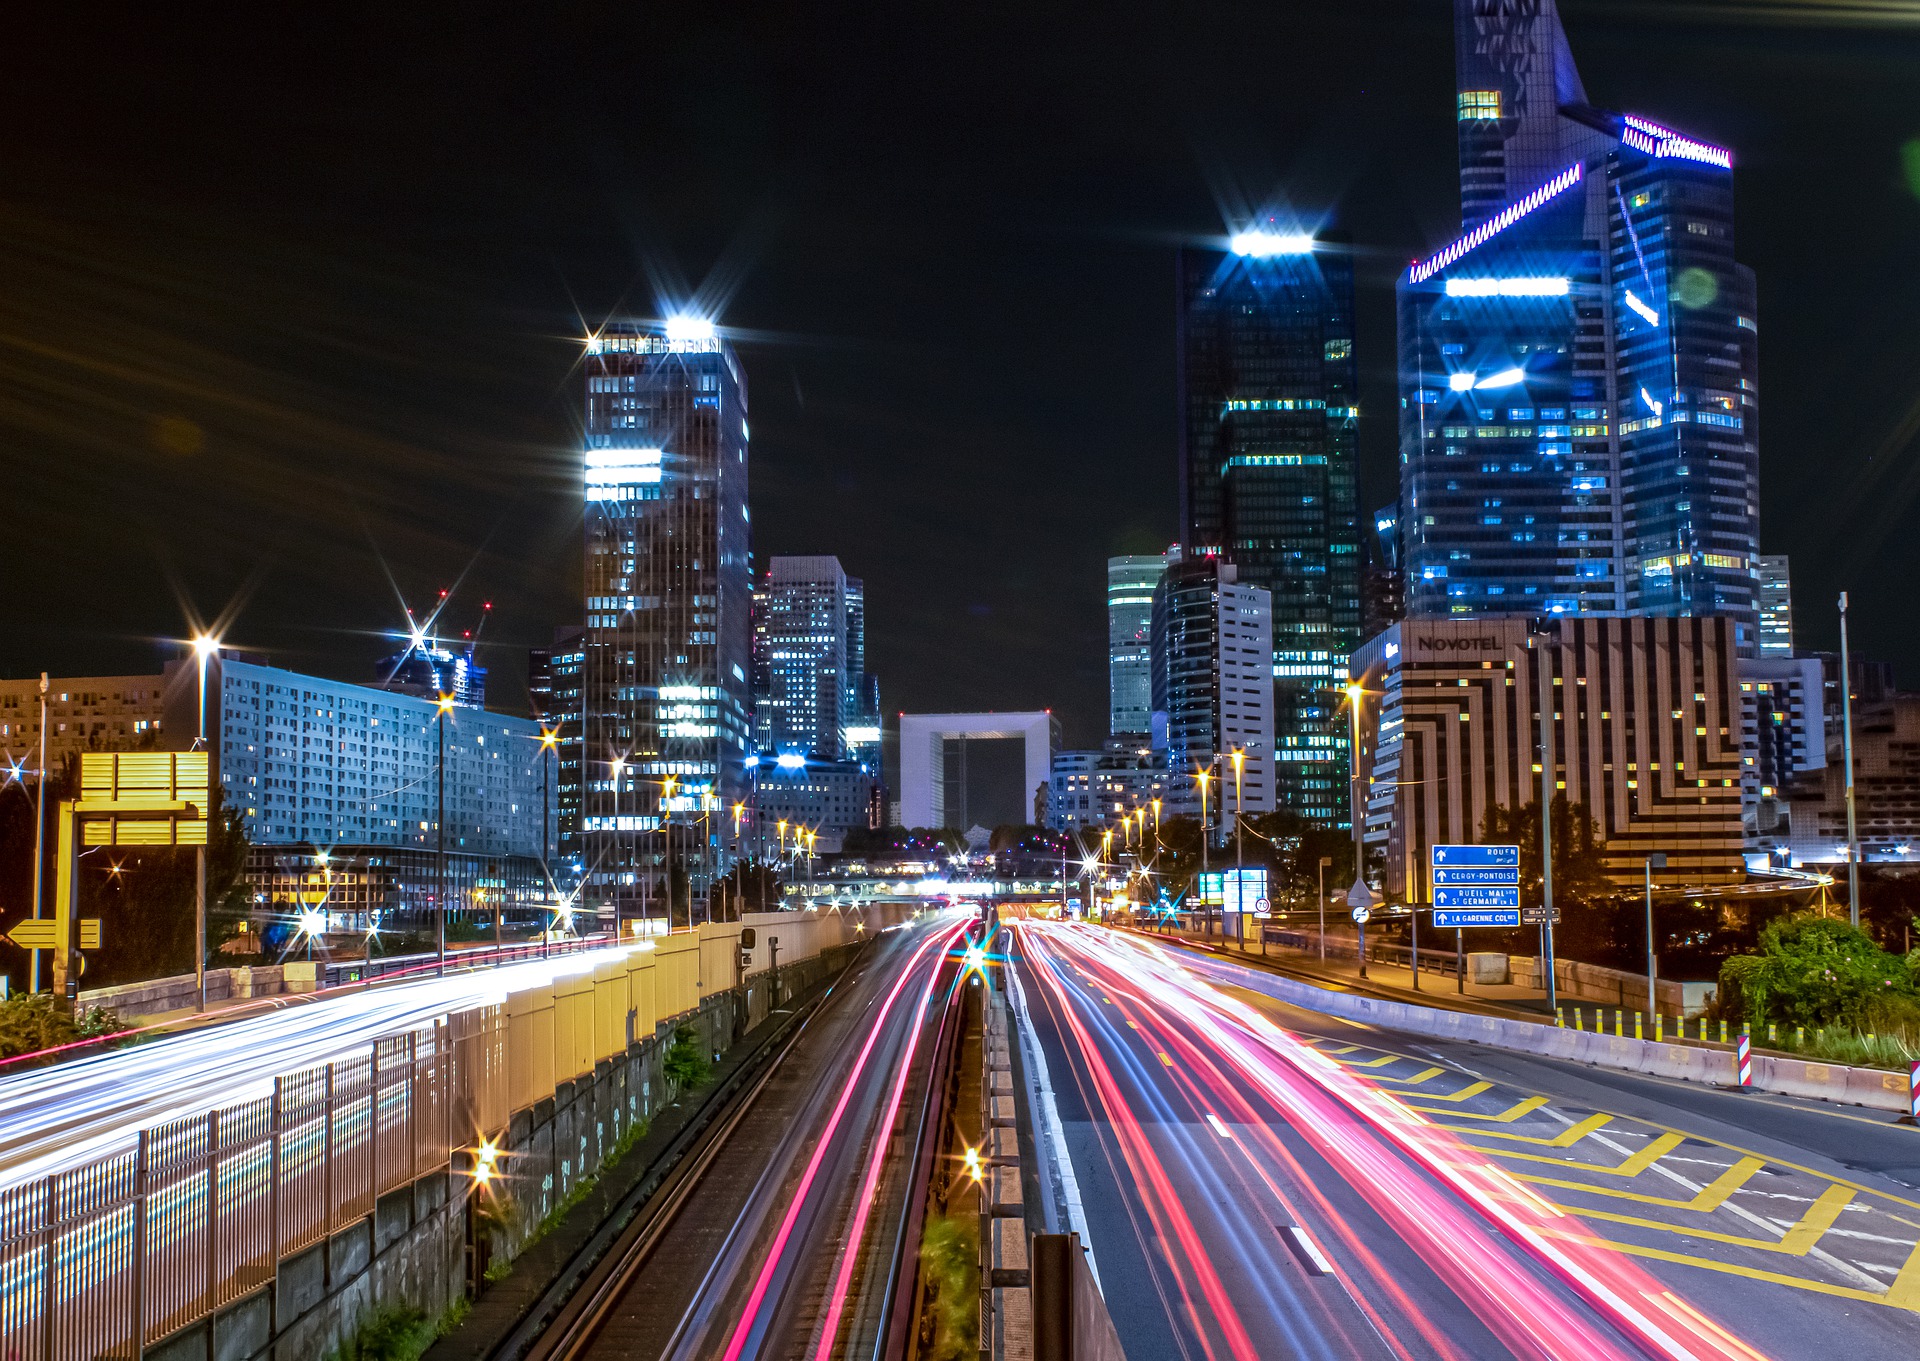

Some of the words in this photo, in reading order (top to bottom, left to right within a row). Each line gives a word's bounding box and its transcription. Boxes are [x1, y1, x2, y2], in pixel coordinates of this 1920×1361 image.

[1418, 636, 1503, 651] NOVOTEL
[1451, 872, 1516, 880] CERGY-PONTOISE
[1462, 897, 1498, 905] GERMAIN
[1451, 914, 1461, 922] LA
[1462, 914, 1493, 922] GARENNE
